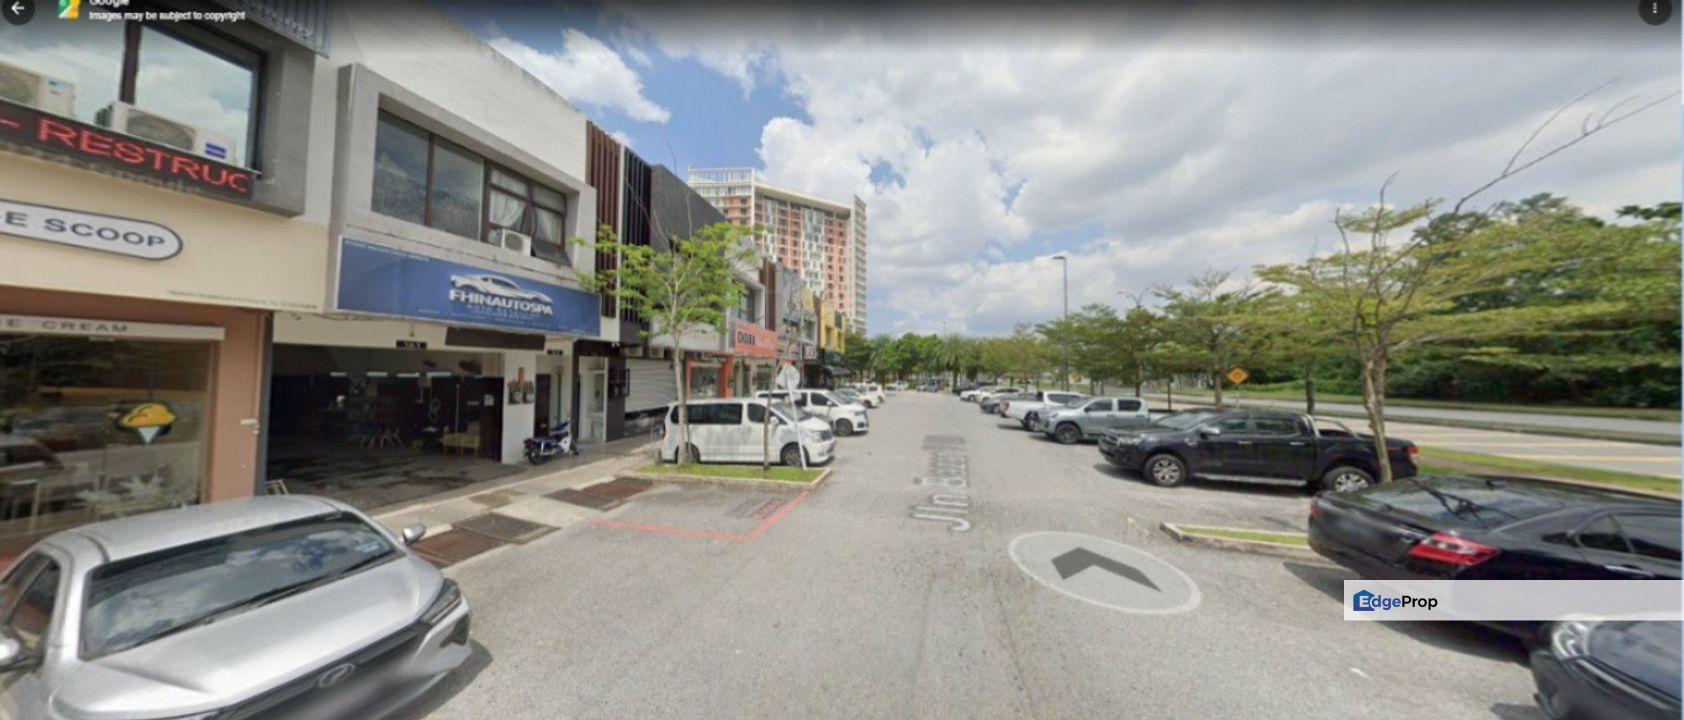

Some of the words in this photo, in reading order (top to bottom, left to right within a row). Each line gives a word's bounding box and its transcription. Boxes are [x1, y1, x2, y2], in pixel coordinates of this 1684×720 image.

[37, 117, 249, 192] RESTRUC
[44, 217, 165, 248] SCOOP
[449, 288, 554, 316] FHINAUTOSPA
[41, 320, 128, 333] CREAM
